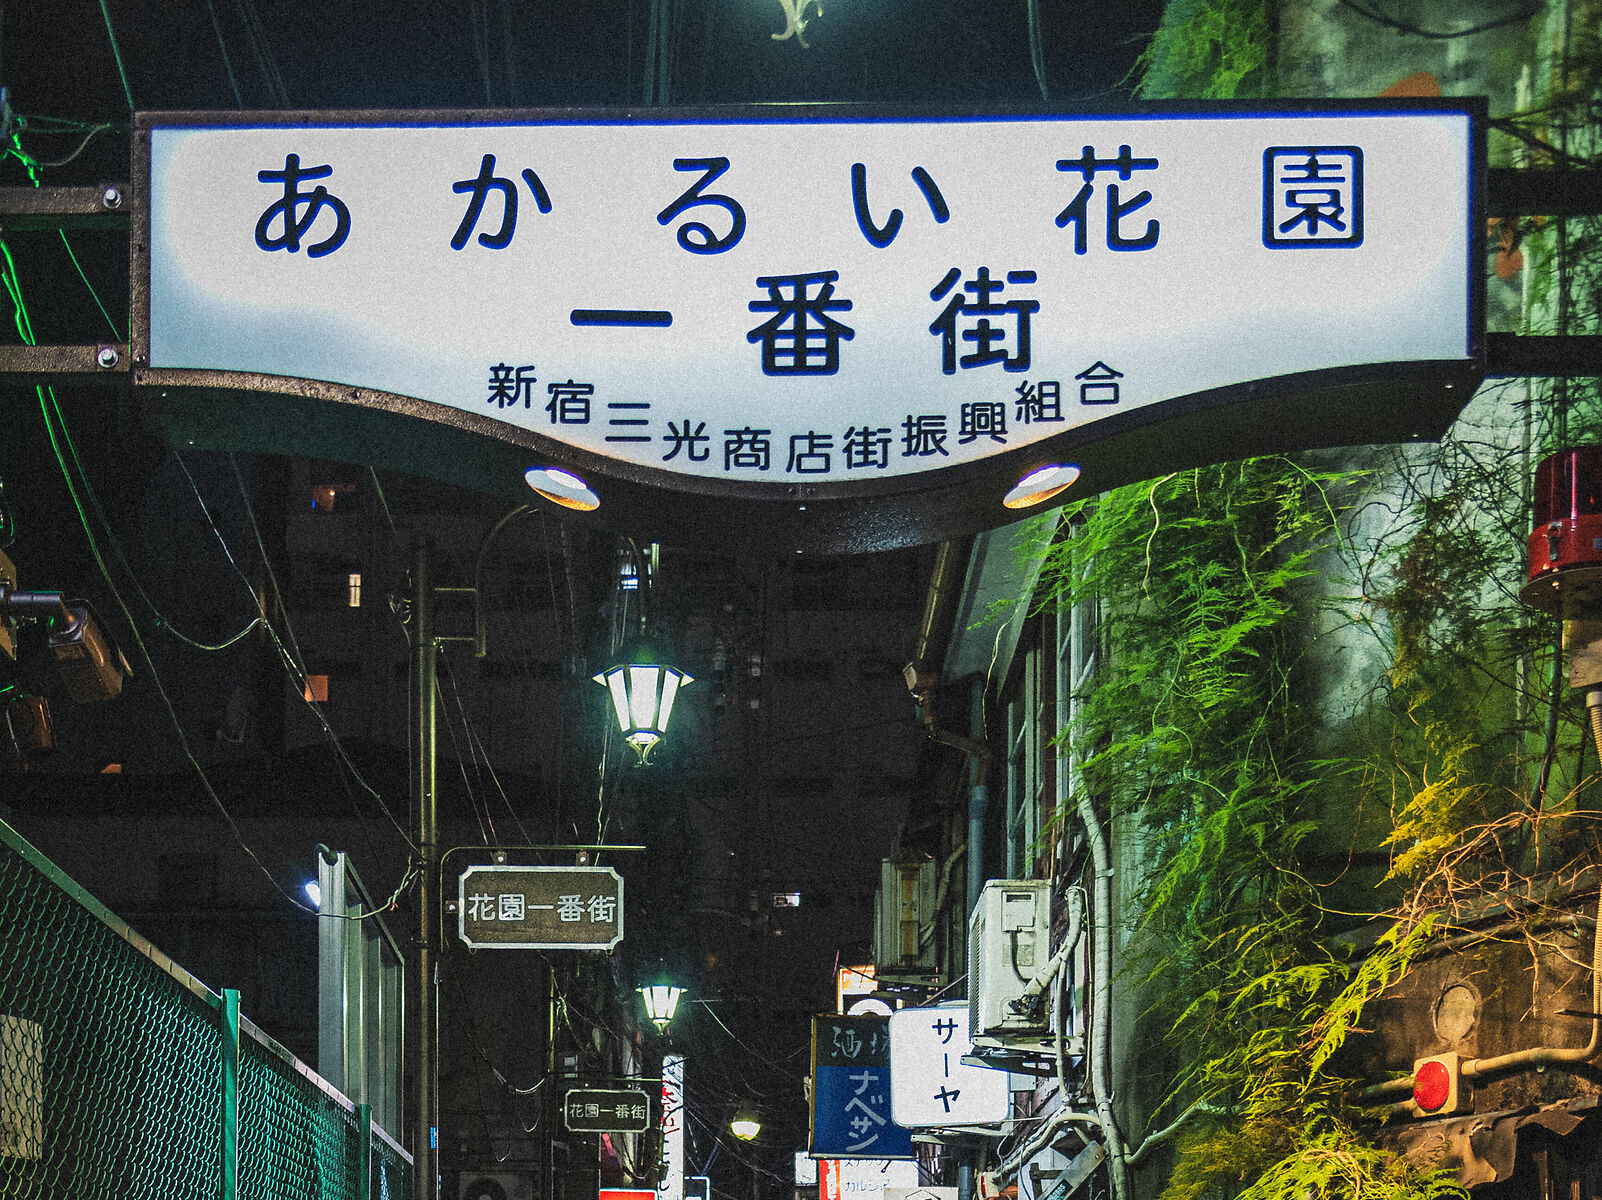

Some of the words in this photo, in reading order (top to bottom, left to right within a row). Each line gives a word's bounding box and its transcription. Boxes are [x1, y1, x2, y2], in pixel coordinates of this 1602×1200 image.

[254, 143, 1365, 257] あかるい花園
[569, 267, 1041, 377] 一番街
[487, 359, 1125, 476] 新宿三光商店街振興組合
[467, 892, 617, 923] 花園一番街
[569, 1103, 647, 1120] 花園一番街
[844, 1070, 887, 1151] ナベサン
[931, 1018, 961, 1113] サーヤ
